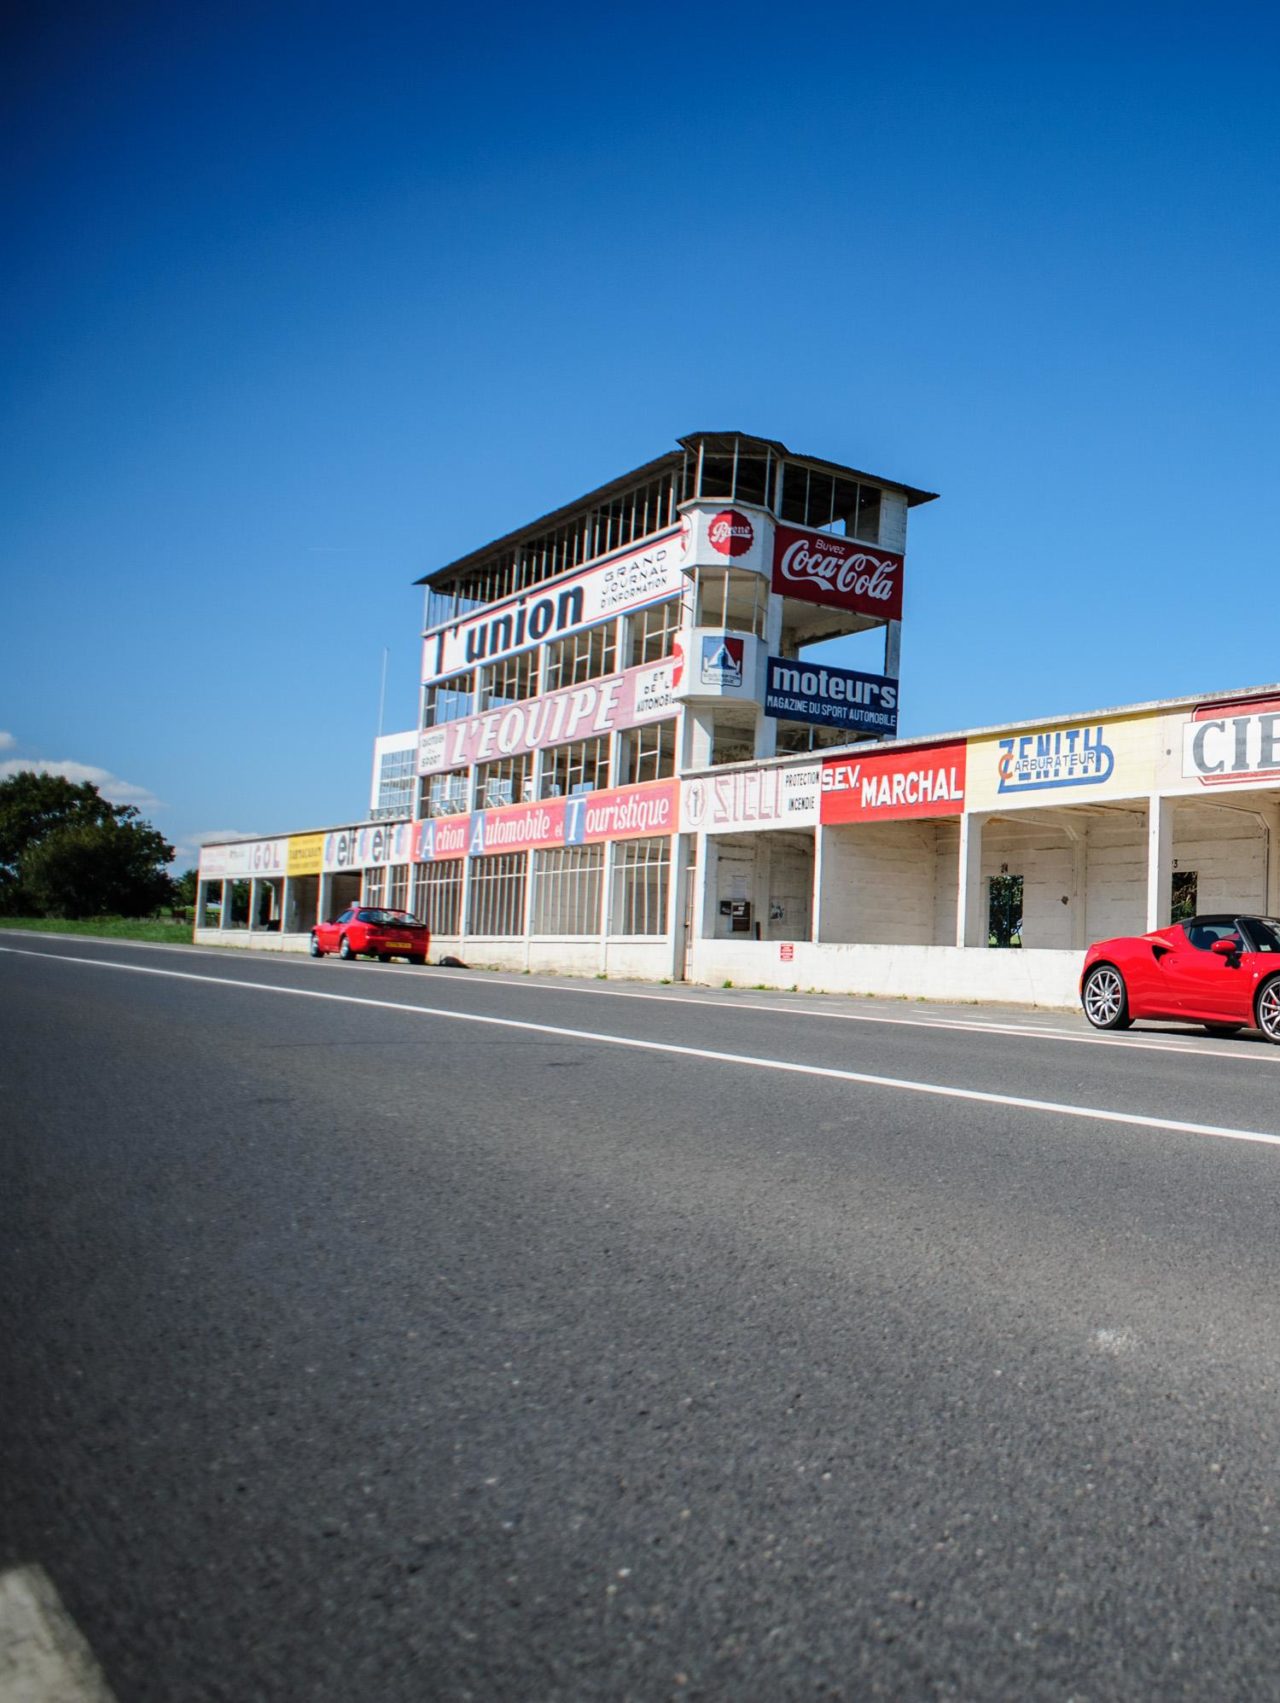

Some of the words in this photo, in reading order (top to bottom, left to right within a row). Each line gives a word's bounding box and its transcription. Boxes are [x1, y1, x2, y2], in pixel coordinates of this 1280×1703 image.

[815, 539, 845, 555] Buvez
[602, 565, 667, 595] JOURNAL
[605, 550, 666, 582] GRAND
[781, 540, 897, 600] Coca-Cola
[601, 577, 667, 608] D'INFORMATION
[644, 684, 656, 695] DE
[653, 671, 664, 681] ET
[772, 666, 897, 709] moteurs
[766, 695, 809, 713] MAGAZINE
[809, 702, 820, 714] DU
[821, 704, 848, 718] SPORT
[849, 709, 896, 727] AUTOMOBILE
[998, 726, 1114, 793] ZENITH
[998, 752, 1095, 778] CARBURATEUR
[785, 771, 819, 786] PROTECTION
[861, 767, 964, 808] MARCHAL
[788, 796, 815, 811] INCENDIE
[469, 808, 550, 853] Automobile
[567, 794, 669, 841] Touristique
[248, 843, 280, 870] IGOL
[337, 827, 357, 866] elf
[372, 823, 393, 863] elf
